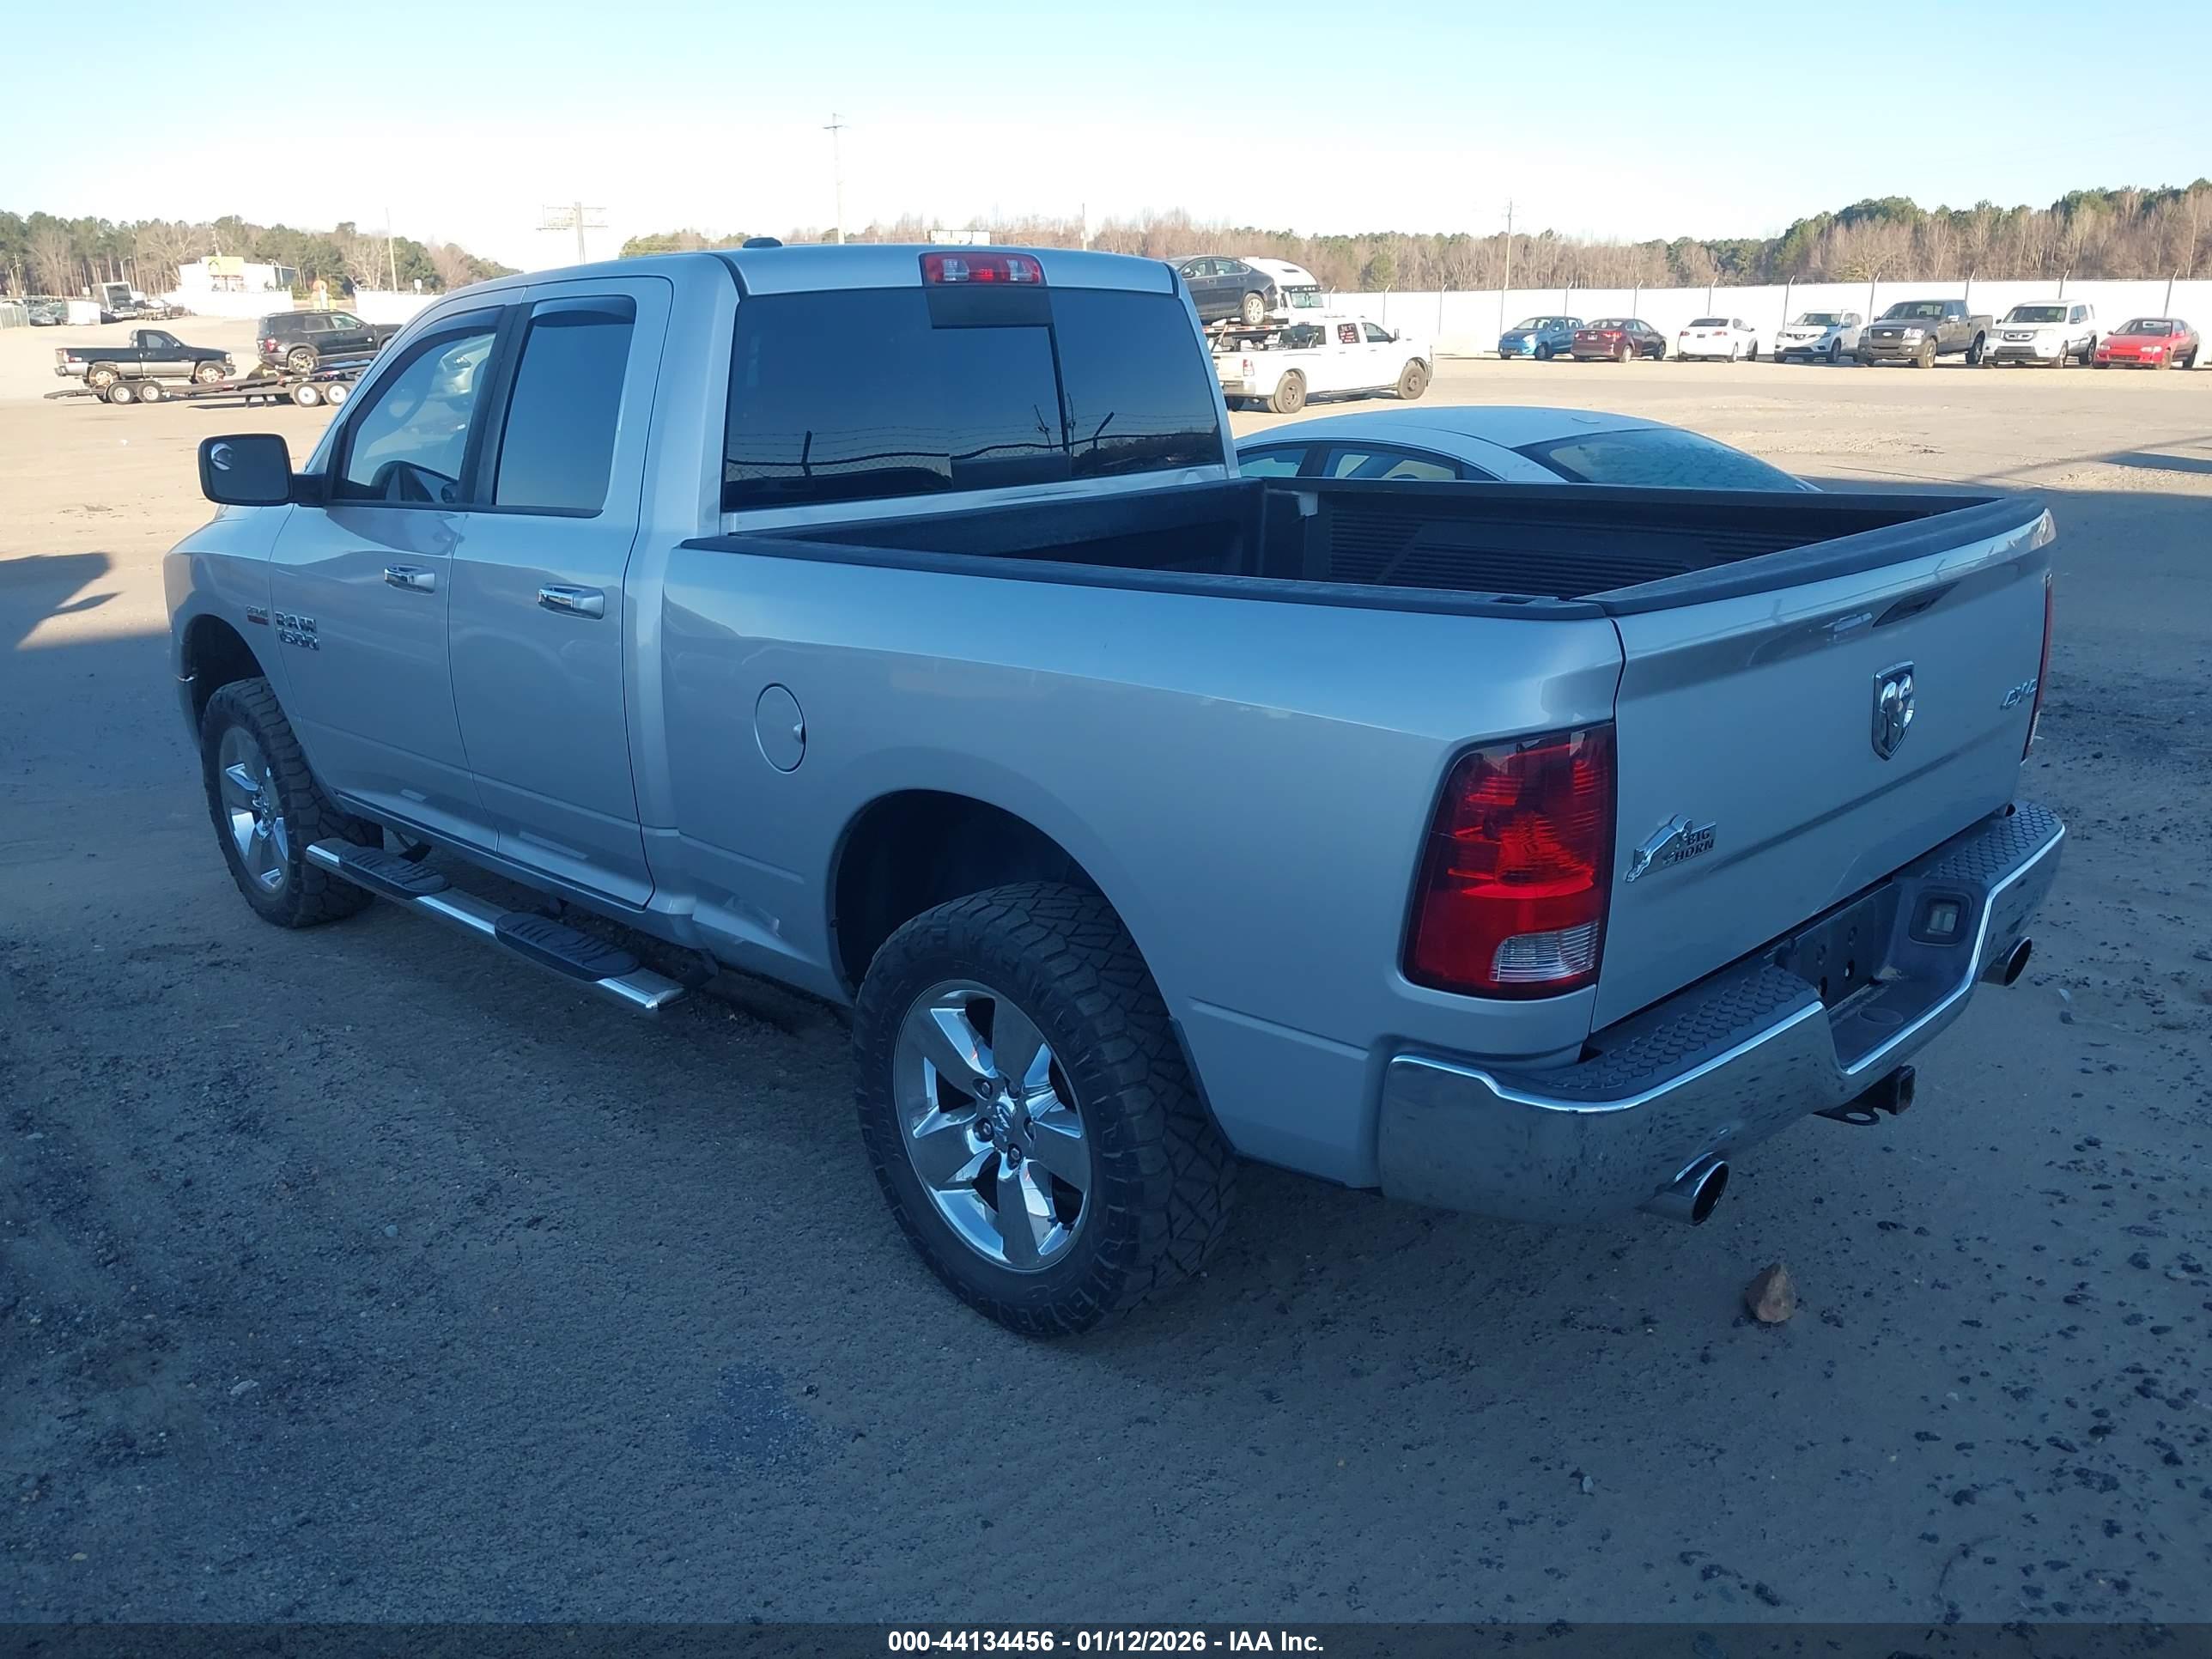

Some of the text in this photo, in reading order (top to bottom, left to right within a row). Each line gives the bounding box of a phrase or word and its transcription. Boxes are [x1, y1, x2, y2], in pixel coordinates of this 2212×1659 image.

[274, 611, 318, 633] RAM
[1686, 829, 1711, 847] BIG
[1674, 839, 1715, 862] HORN
